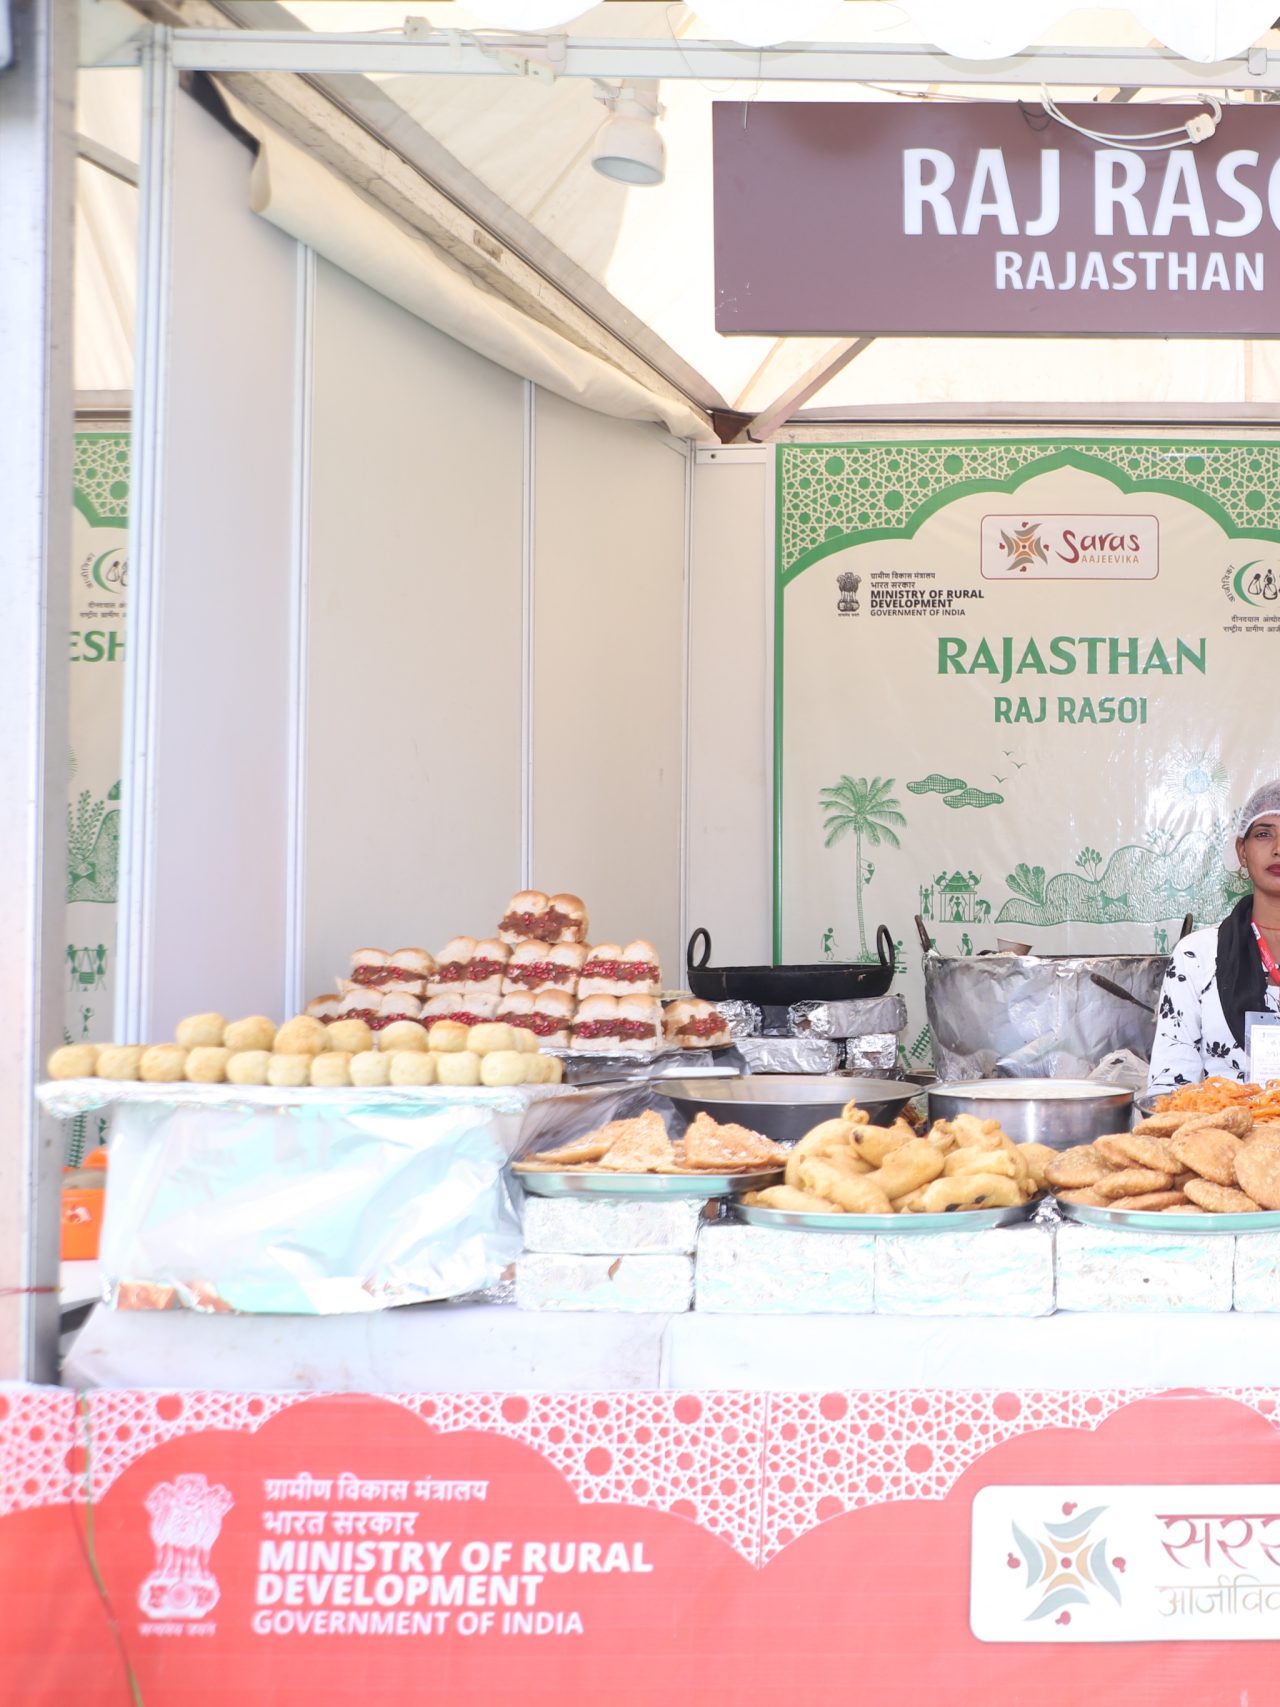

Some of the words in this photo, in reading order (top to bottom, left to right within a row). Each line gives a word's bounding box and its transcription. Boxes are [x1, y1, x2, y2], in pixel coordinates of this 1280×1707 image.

[902, 148, 1060, 236] RAJ
[995, 251, 1264, 292] RAJASTHAN
[1055, 529, 1140, 564] Saras
[1081, 555, 1140, 564] AAJEEVIKA
[870, 571, 890, 580] ग्रामीण
[891, 571, 912, 580] विकास
[914, 571, 936, 580] मंत्रालय
[870, 581, 889, 589] भारत
[891, 581, 916, 590] सरकार
[870, 590, 926, 599] MINISTRY
[929, 590, 944, 599] OF
[947, 589, 984, 599] RURAL
[870, 599, 953, 608] DEVELOPMENT
[870, 609, 927, 617] GOVERNMENT
[929, 609, 940, 617] OF
[942, 609, 966, 617] INDIA
[937, 636, 1207, 683] RAJASTHAN
[993, 697, 1048, 724] RAJ
[1058, 697, 1147, 724] RASOI
[263, 1473, 333, 1502] ग्रामीण
[337, 1473, 409, 1502] विकास
[414, 1475, 489, 1502] मंत्रालय
[262, 1510, 327, 1535] भारत
[332, 1510, 419, 1536] सरकार
[258, 1542, 453, 1572] MINISTRY
[460, 1542, 513, 1572] OF
[522, 1541, 654, 1573] RURAL
[255, 1574, 543, 1606] DEVELOPMENT
[251, 1610, 450, 1636] GOVERNMENT
[456, 1611, 495, 1635] OF
[502, 1611, 585, 1635] INDIA
